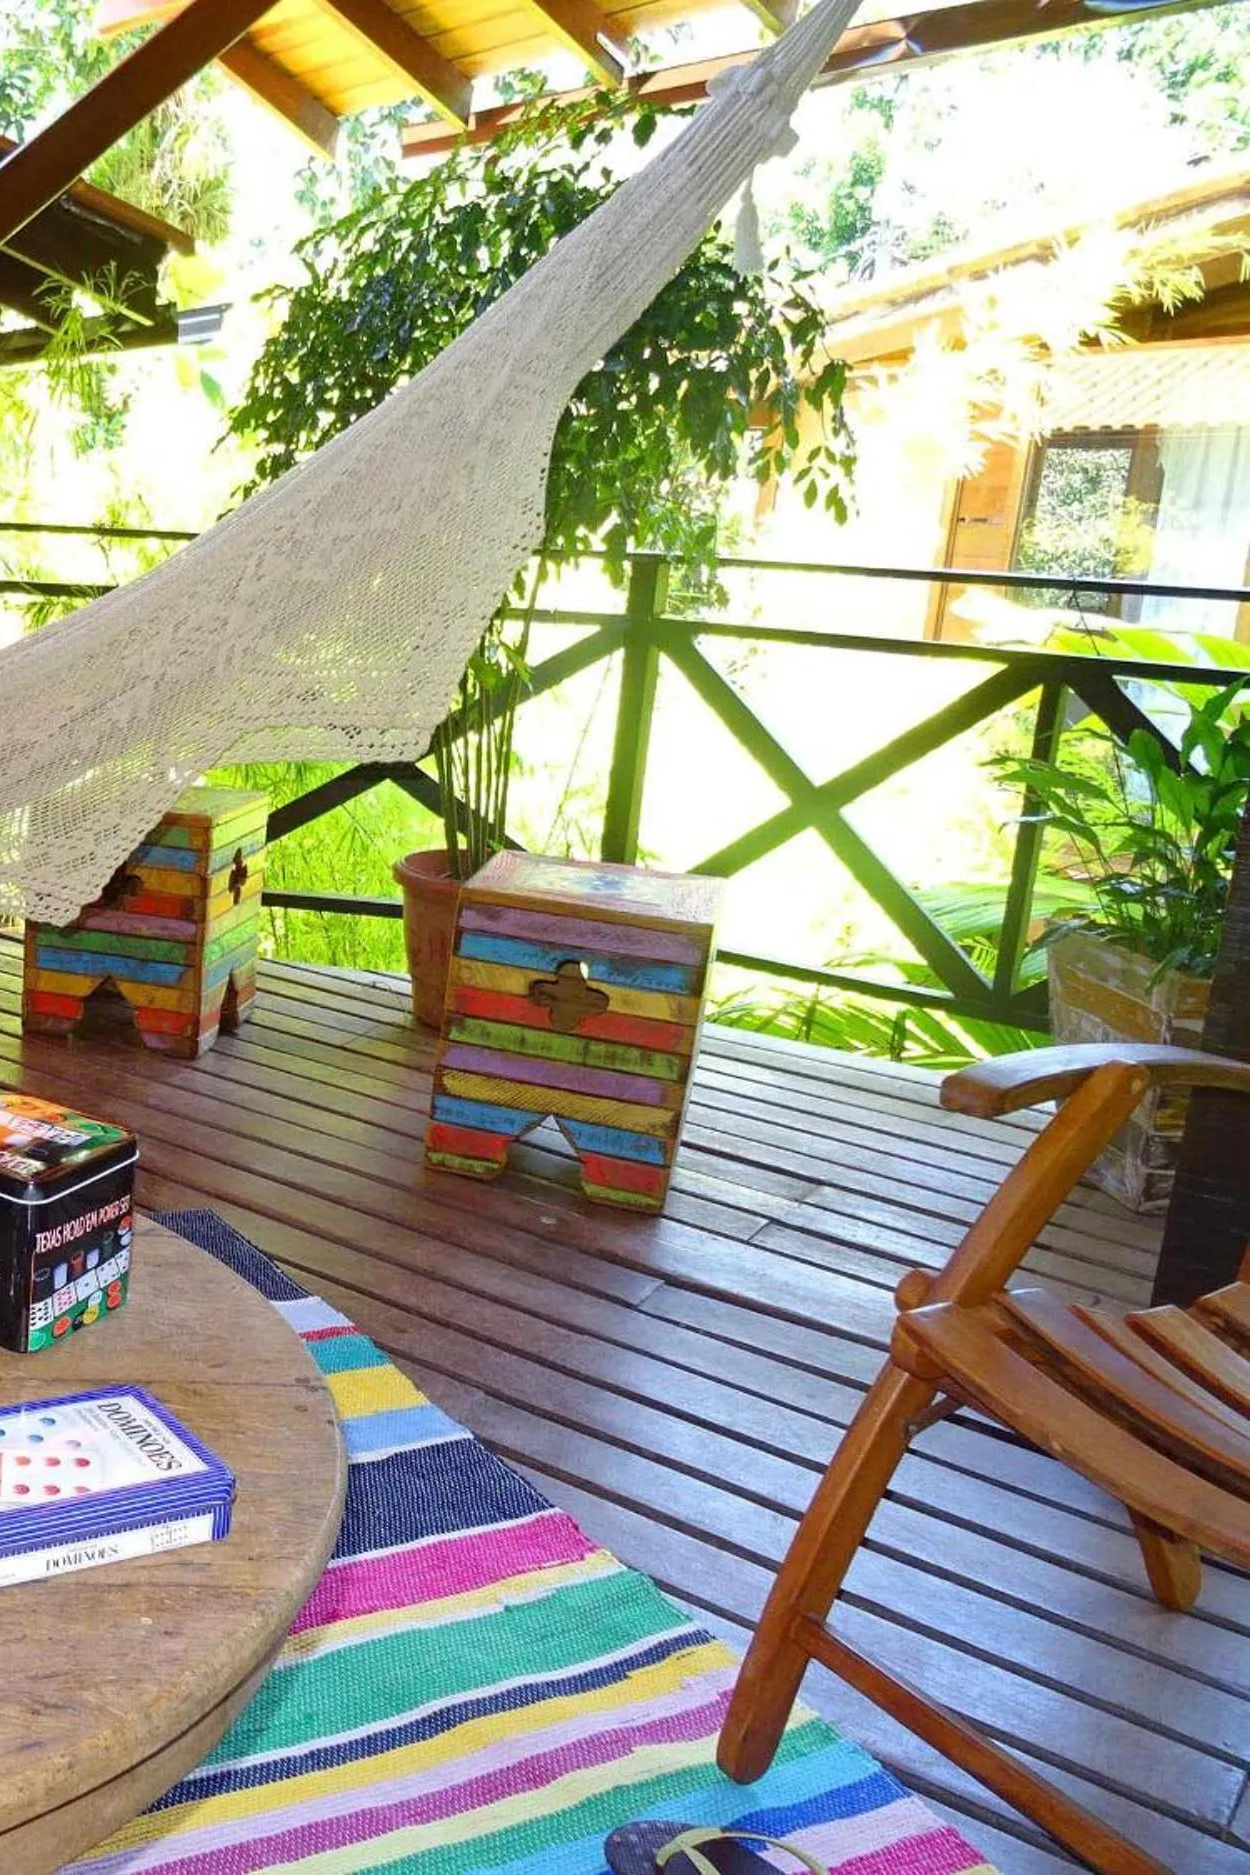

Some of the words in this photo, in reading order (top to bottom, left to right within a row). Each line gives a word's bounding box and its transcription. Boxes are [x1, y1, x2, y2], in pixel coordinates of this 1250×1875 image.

[35, 1226, 62, 1253] TEXAS
[98, 1200, 120, 1223] POKER
[97, 1402, 182, 1471] DOMINOES
[46, 1545, 119, 1572] DOMINOES
